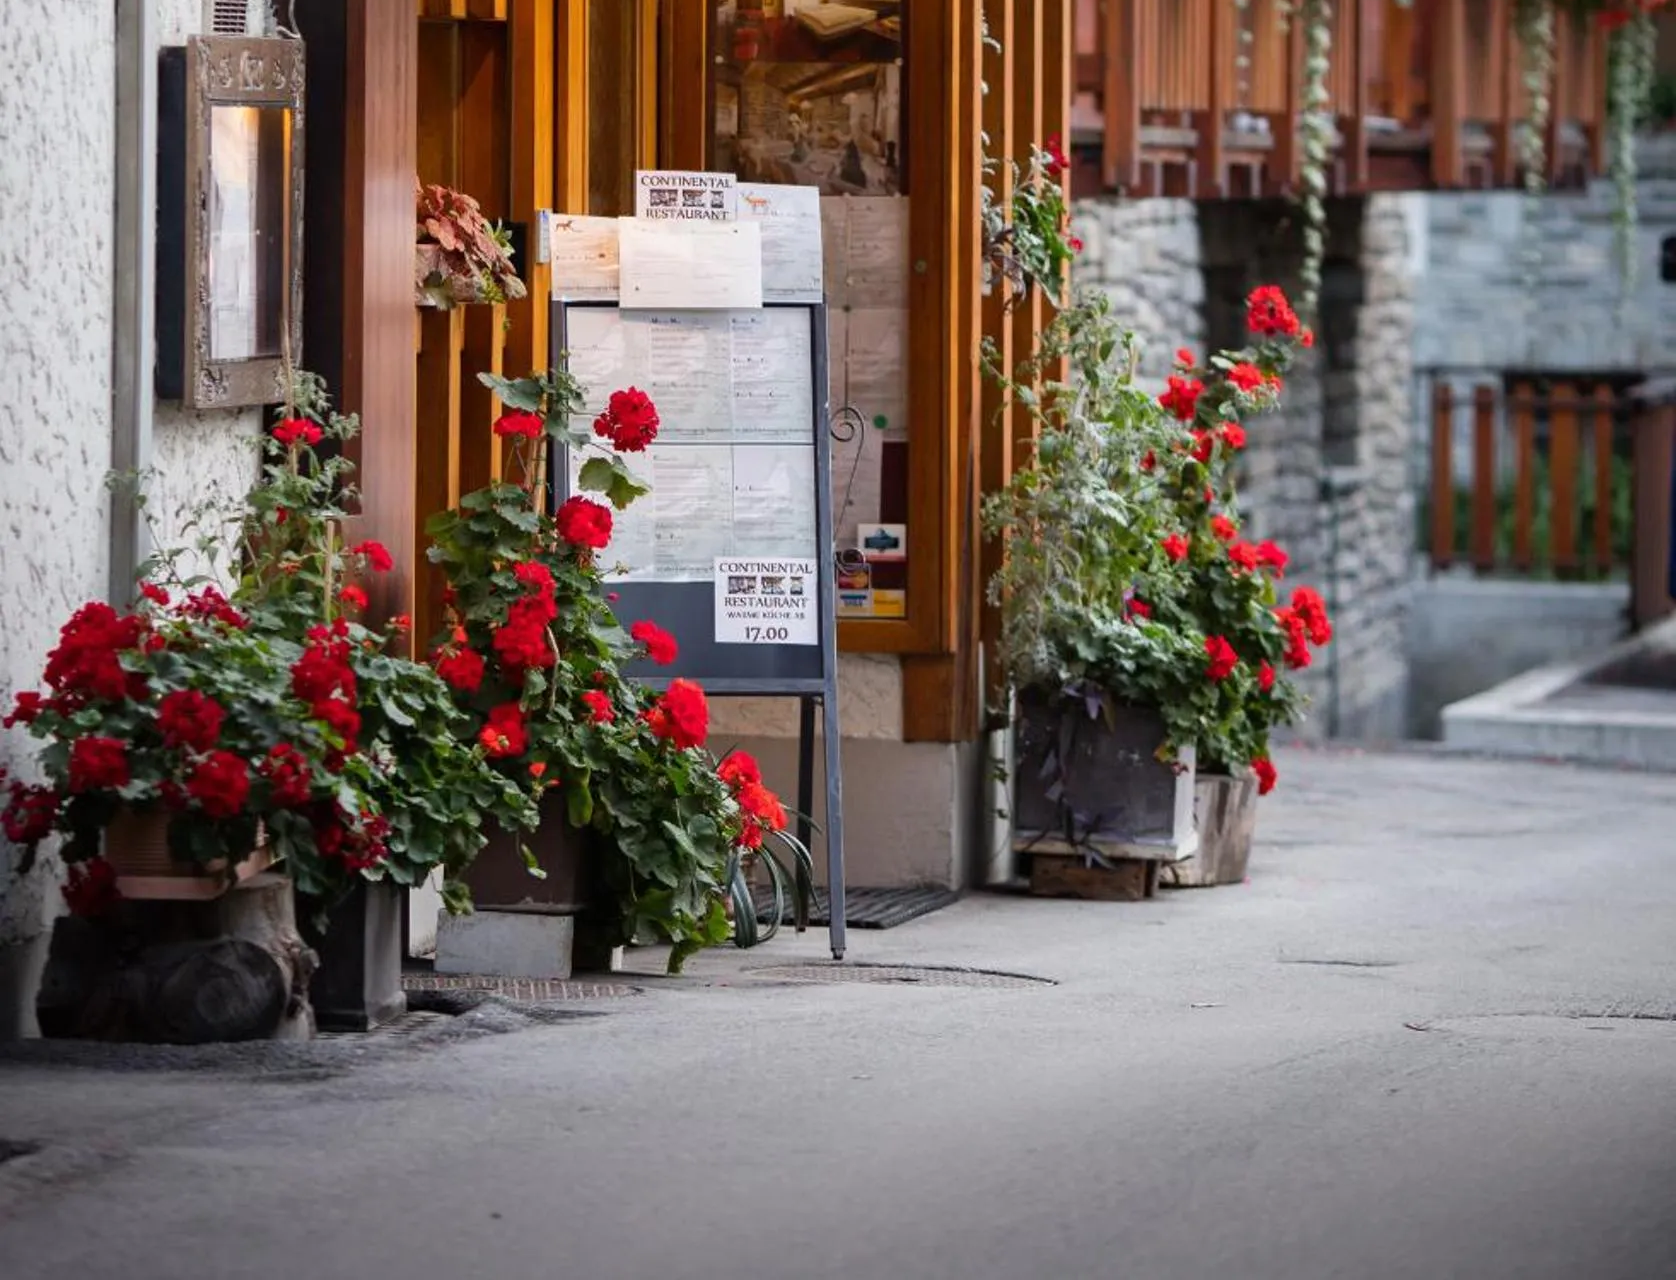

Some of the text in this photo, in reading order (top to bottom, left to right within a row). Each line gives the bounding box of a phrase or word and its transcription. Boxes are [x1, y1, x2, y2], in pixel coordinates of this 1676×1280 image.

[641, 175, 732, 189] CONTINENTAL
[646, 208, 730, 221] RESTAURANT
[719, 562, 813, 574] CONTINENTAL
[724, 597, 808, 608] RESTAURANT
[744, 626, 788, 642] 17.00
